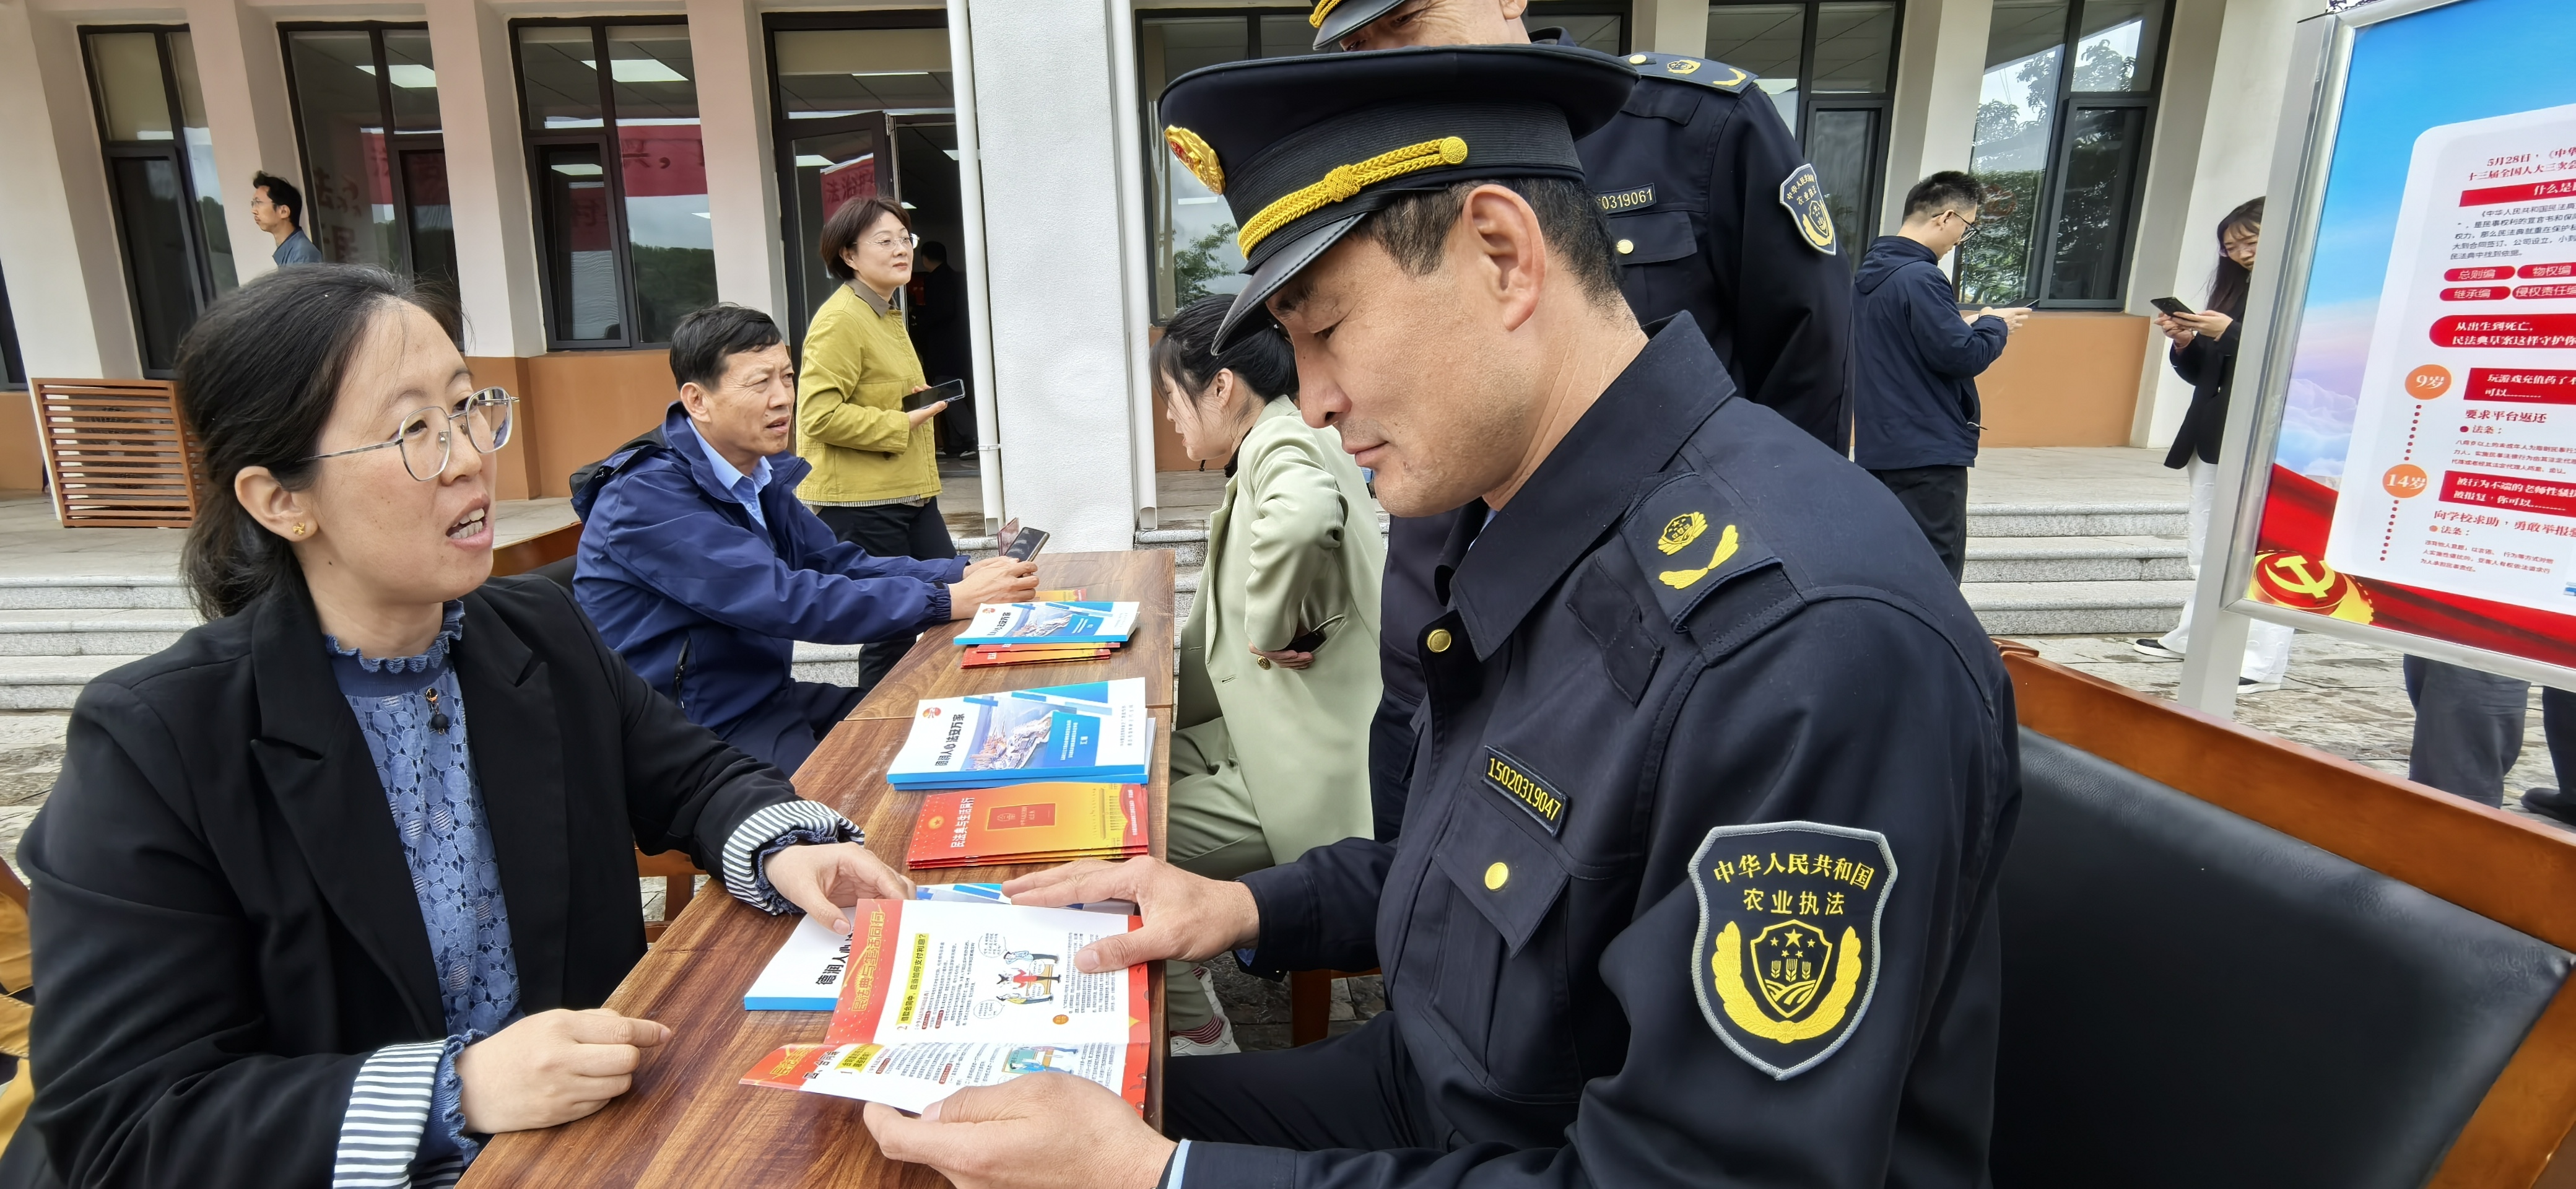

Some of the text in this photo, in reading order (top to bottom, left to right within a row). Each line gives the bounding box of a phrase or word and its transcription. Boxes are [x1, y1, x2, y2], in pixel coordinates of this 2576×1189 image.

[1596, 188, 1653, 209] 0319061
[2458, 269, 2496, 279] 总则编
[2532, 266, 2572, 276] 物权编
[2454, 289, 2491, 298] 继承编
[2515, 285, 2576, 297] 侵权责任编
[2416, 375, 2445, 389] 9岁
[2465, 409, 2548, 423] 要求平台返还
[2387, 474, 2426, 490] 14岁
[945, 713, 965, 743] 法安万家
[1487, 758, 1561, 821] 15020319047
[951, 797, 975, 848] 民法典与生活同行
[1713, 852, 1874, 890] 中华人民共和国
[1743, 887, 1845, 915] 农业执法
[852, 910, 885, 1011] 民法典与生活同行
